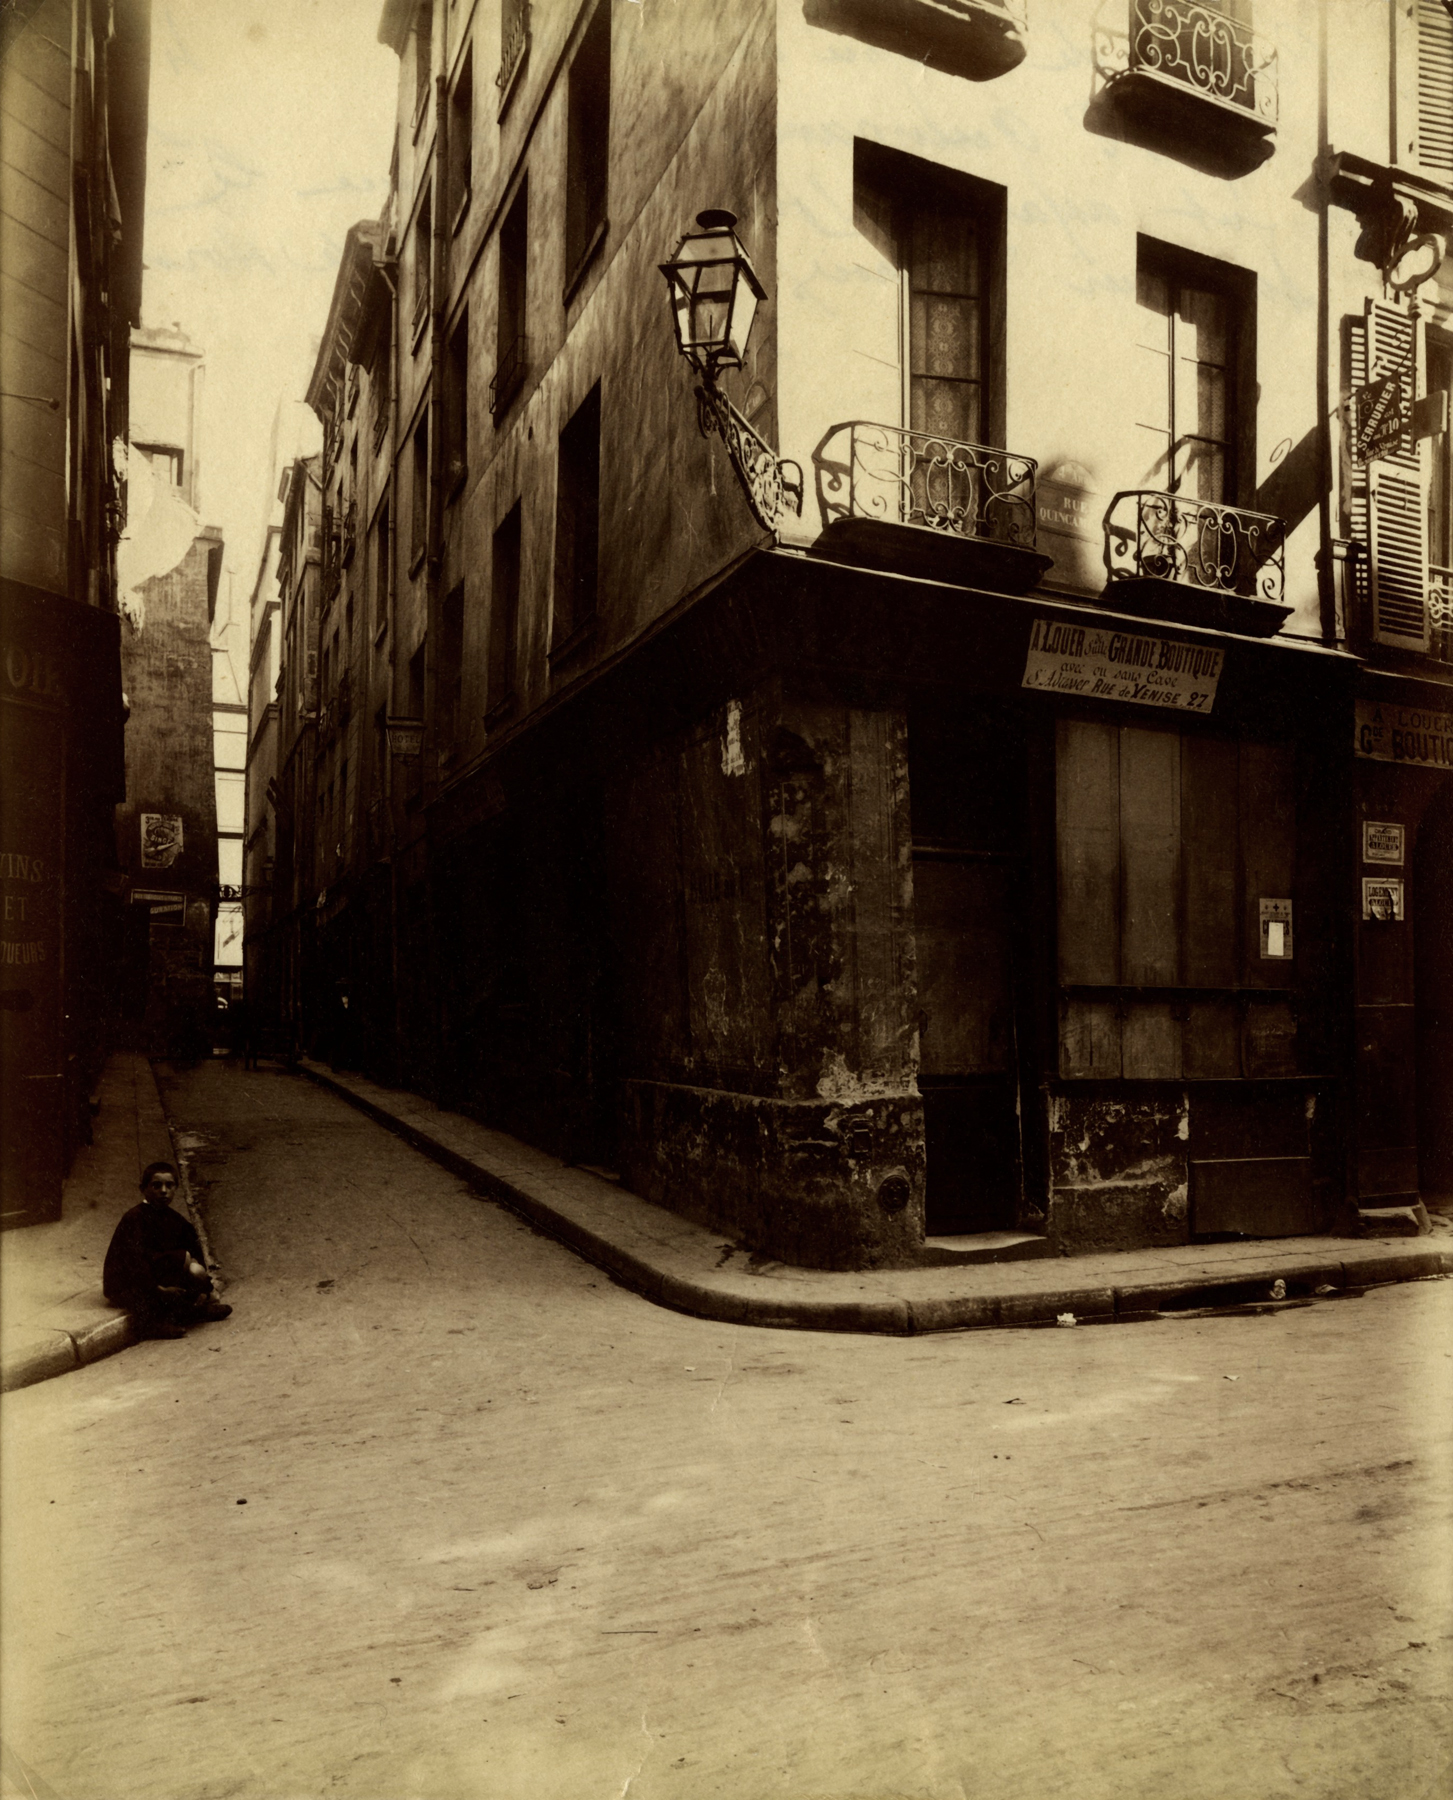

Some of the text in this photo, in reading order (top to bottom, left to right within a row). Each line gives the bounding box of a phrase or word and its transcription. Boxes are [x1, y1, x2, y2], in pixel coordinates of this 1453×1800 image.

[1357, 381, 1397, 451] SERRURIER
[1063, 496, 1088, 513] RUE
[1030, 622, 1041, 651] A
[1040, 622, 1086, 657] LOUER
[1108, 633, 1157, 668] GRANDE
[1156, 640, 1220, 680] BOUTIQUE
[1061, 662, 1178, 687] avec ou sans Cave
[1091, 678, 1116, 695] RUE
[1118, 686, 1130, 697] de
[1187, 691, 1209, 708] 27
[1372, 708, 1384, 723] A
[391, 735, 420, 744] HOTEL
[4, 895, 28, 921] ET
